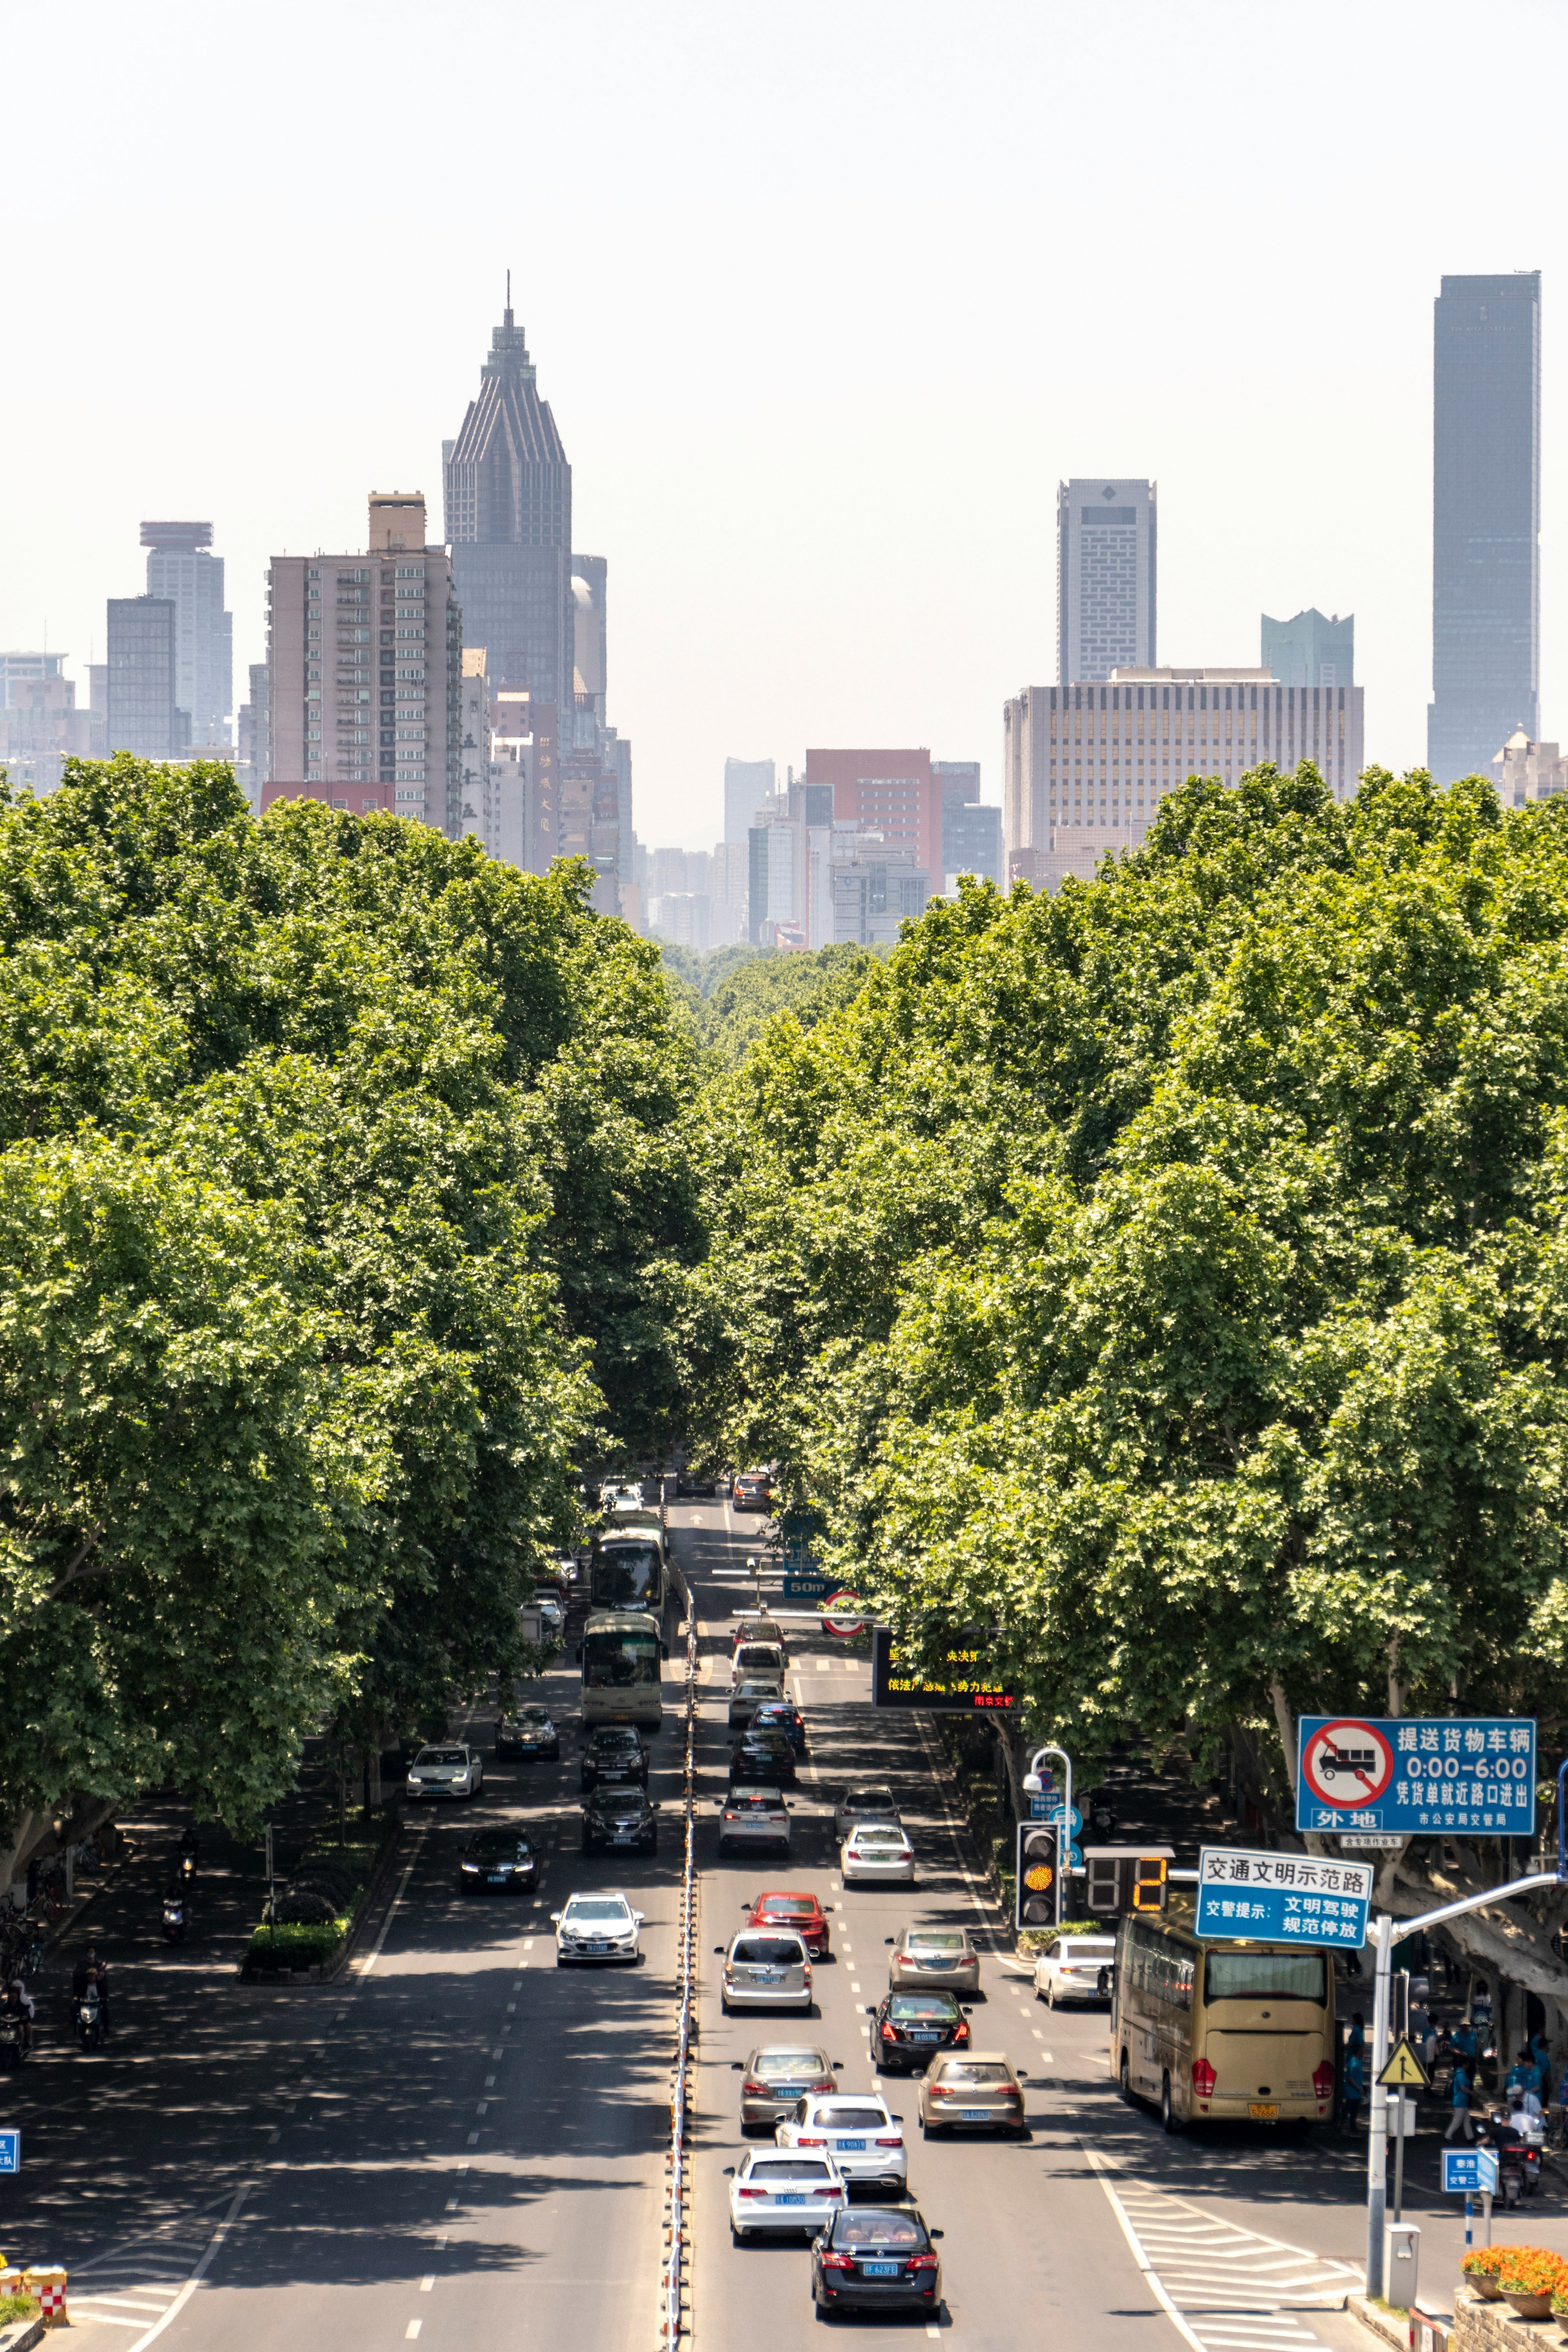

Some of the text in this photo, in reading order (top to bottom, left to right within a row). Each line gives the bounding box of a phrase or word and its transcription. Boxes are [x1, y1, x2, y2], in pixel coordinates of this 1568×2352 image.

[791, 1583, 825, 1592] 50m
[1398, 1727, 1530, 1753] 提送货物车辆
[1407, 1757, 1527, 1779] 0:00-6:00
[1396, 1782, 1527, 1807] 凭货单就近路口进出
[1317, 1811, 1377, 1828] 外地
[1420, 1813, 1506, 1826] 市公安局交管局
[1346, 1838, 1398, 1846] 含专项作业车
[1134, 1857, 1167, 1911] 2
[1207, 1858, 1364, 1894] 交通文明示范路
[1285, 1897, 1359, 1919] 文明驾驶
[1283, 1917, 1357, 1939] 规范停放
[1450, 2176, 1479, 2185] 交警二
